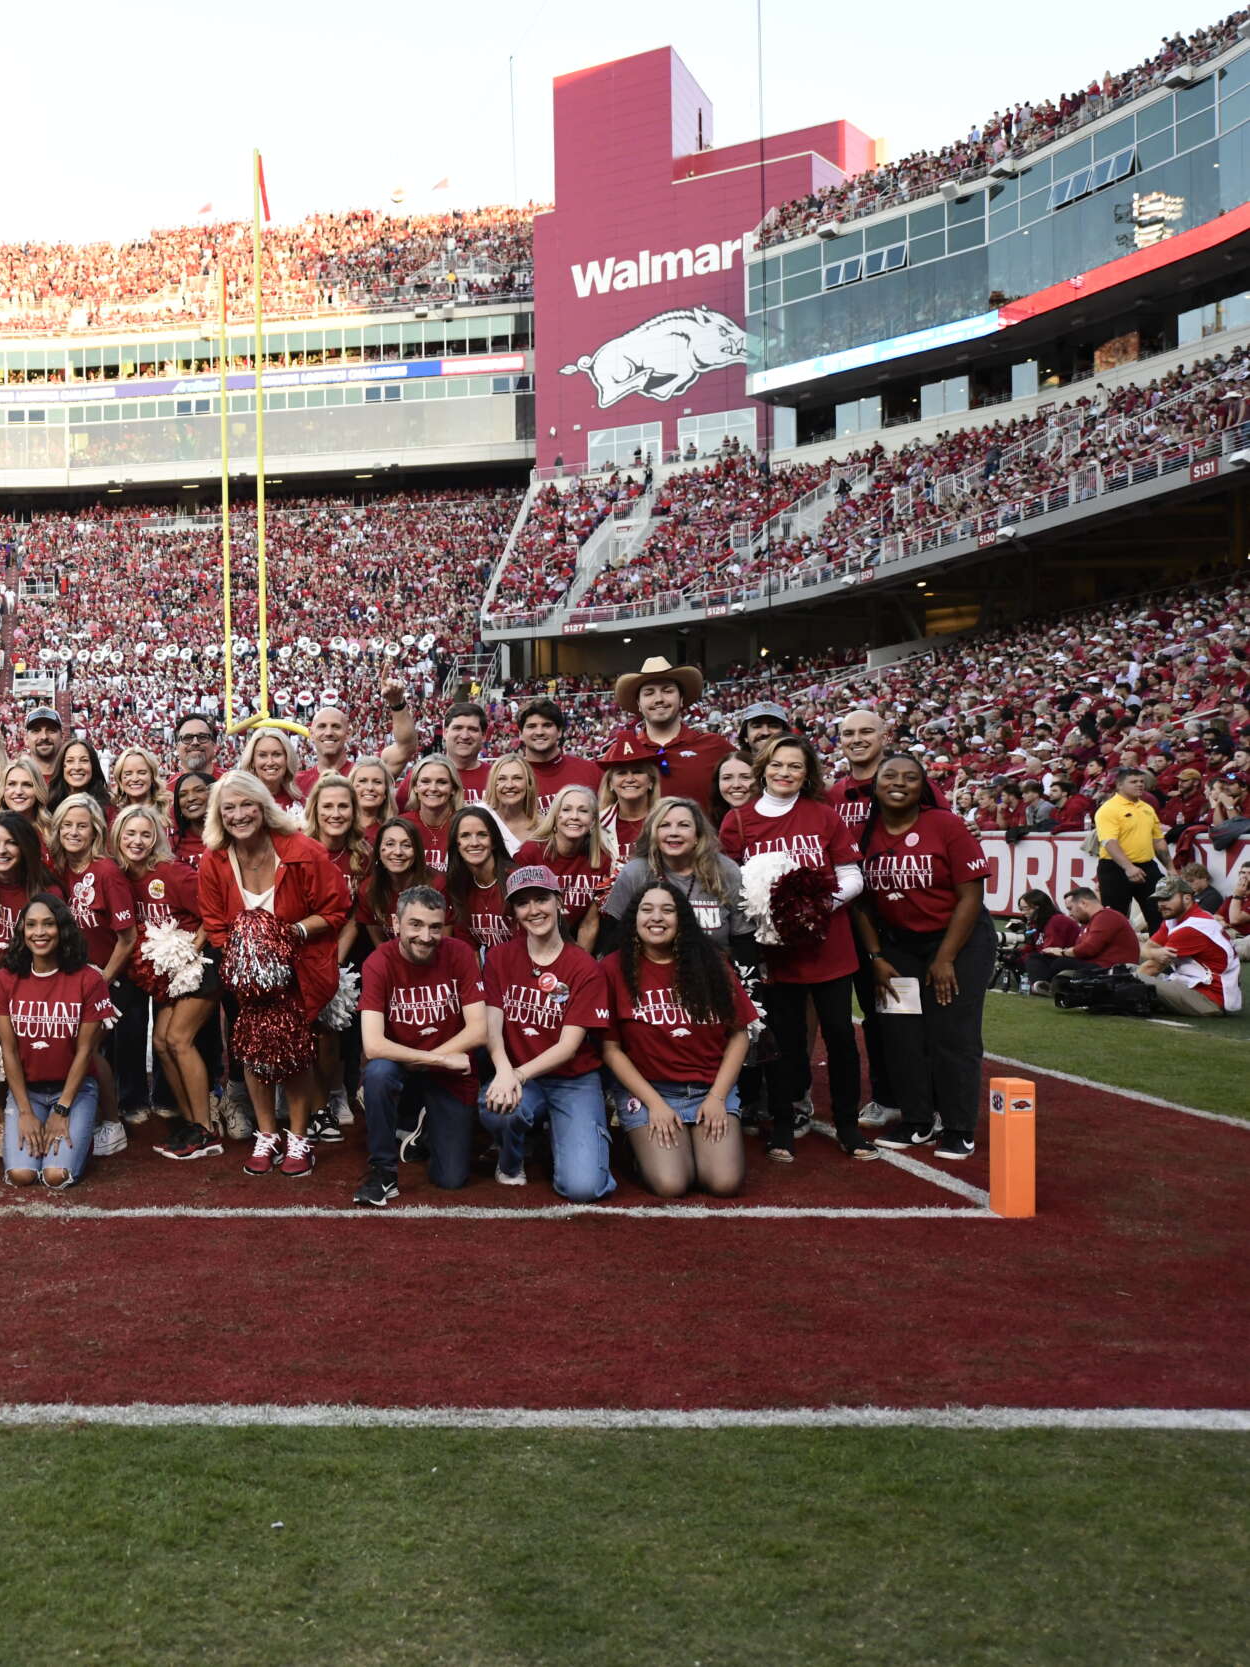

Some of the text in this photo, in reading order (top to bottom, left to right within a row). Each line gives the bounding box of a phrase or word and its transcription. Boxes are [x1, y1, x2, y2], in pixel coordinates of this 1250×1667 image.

[571, 238, 742, 298] Walmar
[1193, 461, 1215, 478] S131
[979, 532, 995, 546] S130
[706, 605, 726, 616] S128
[563, 623, 583, 633] S127
[623, 742, 635, 756] A
[115, 909, 131, 922] WPS
[95, 998, 112, 1012] WPS
[389, 978, 462, 1026] ALUMN
[502, 984, 567, 1030] ALUMN
